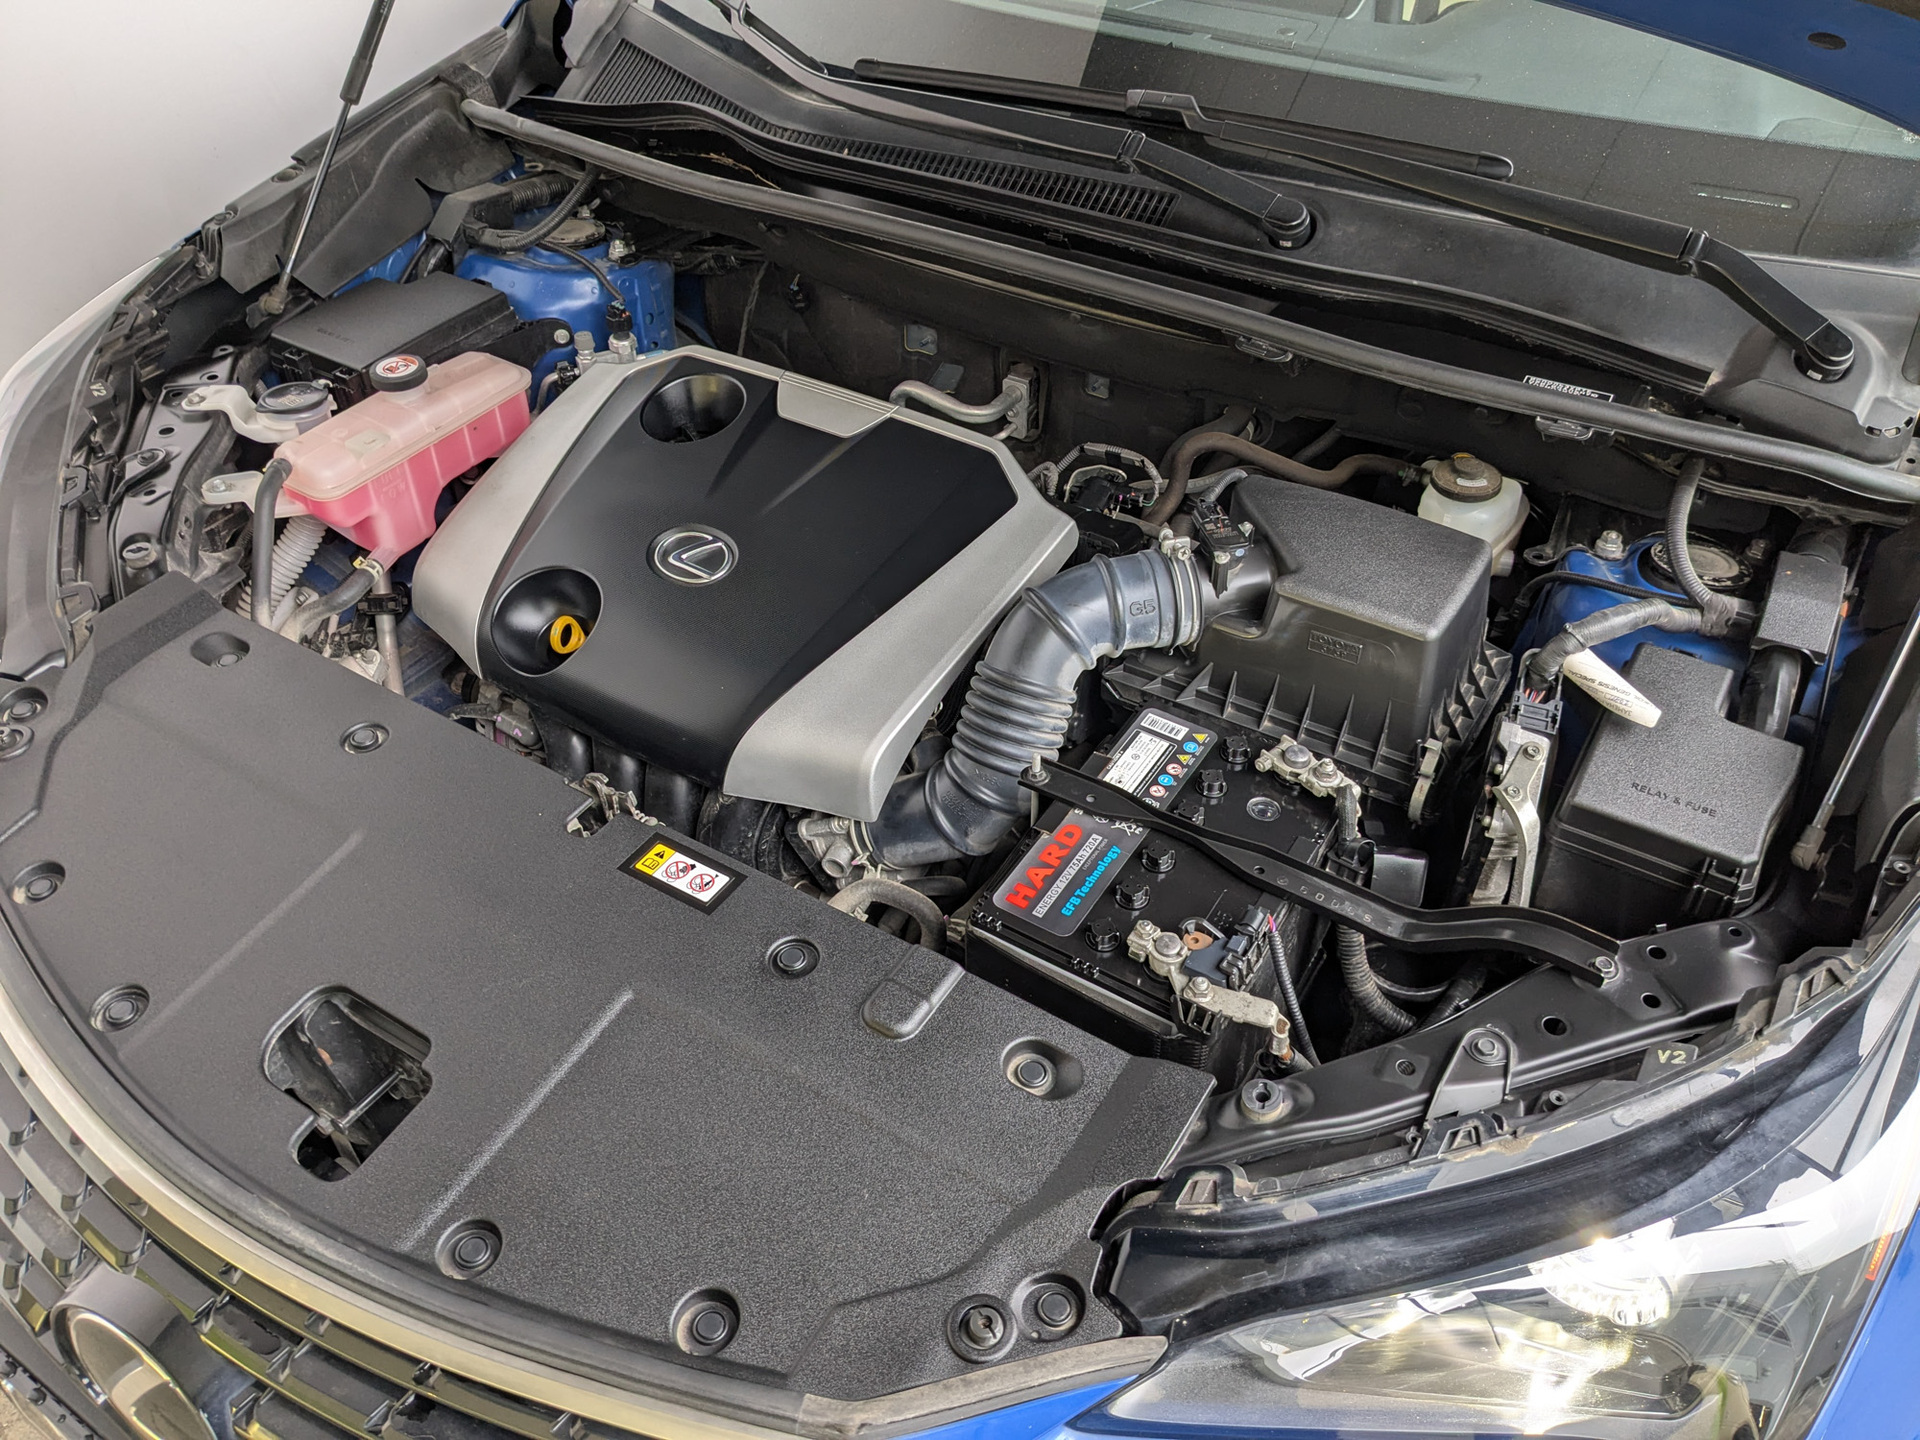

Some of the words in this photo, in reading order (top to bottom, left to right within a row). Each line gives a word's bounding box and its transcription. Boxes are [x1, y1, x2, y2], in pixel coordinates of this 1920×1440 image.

[90, 383, 107, 397] V2
[1129, 599, 1157, 617] G5
[1567, 669, 1596, 684] SPECIAL
[1598, 681, 1631, 697] GENESIS
[1631, 782, 1669, 800] RELAY
[1673, 797, 1681, 806] &
[1685, 801, 1717, 818] FUSE
[1005, 824, 1083, 910] HARD
[1035, 885, 1062, 916] ENERGY
[1059, 869, 1074, 886] 12V
[1071, 854, 1087, 872] 75Ah
[1083, 837, 1100, 856] 720A
[1061, 896, 1082, 917] EFB
[1074, 845, 1122, 897] Technology
[1657, 1049, 1687, 1065] V2
